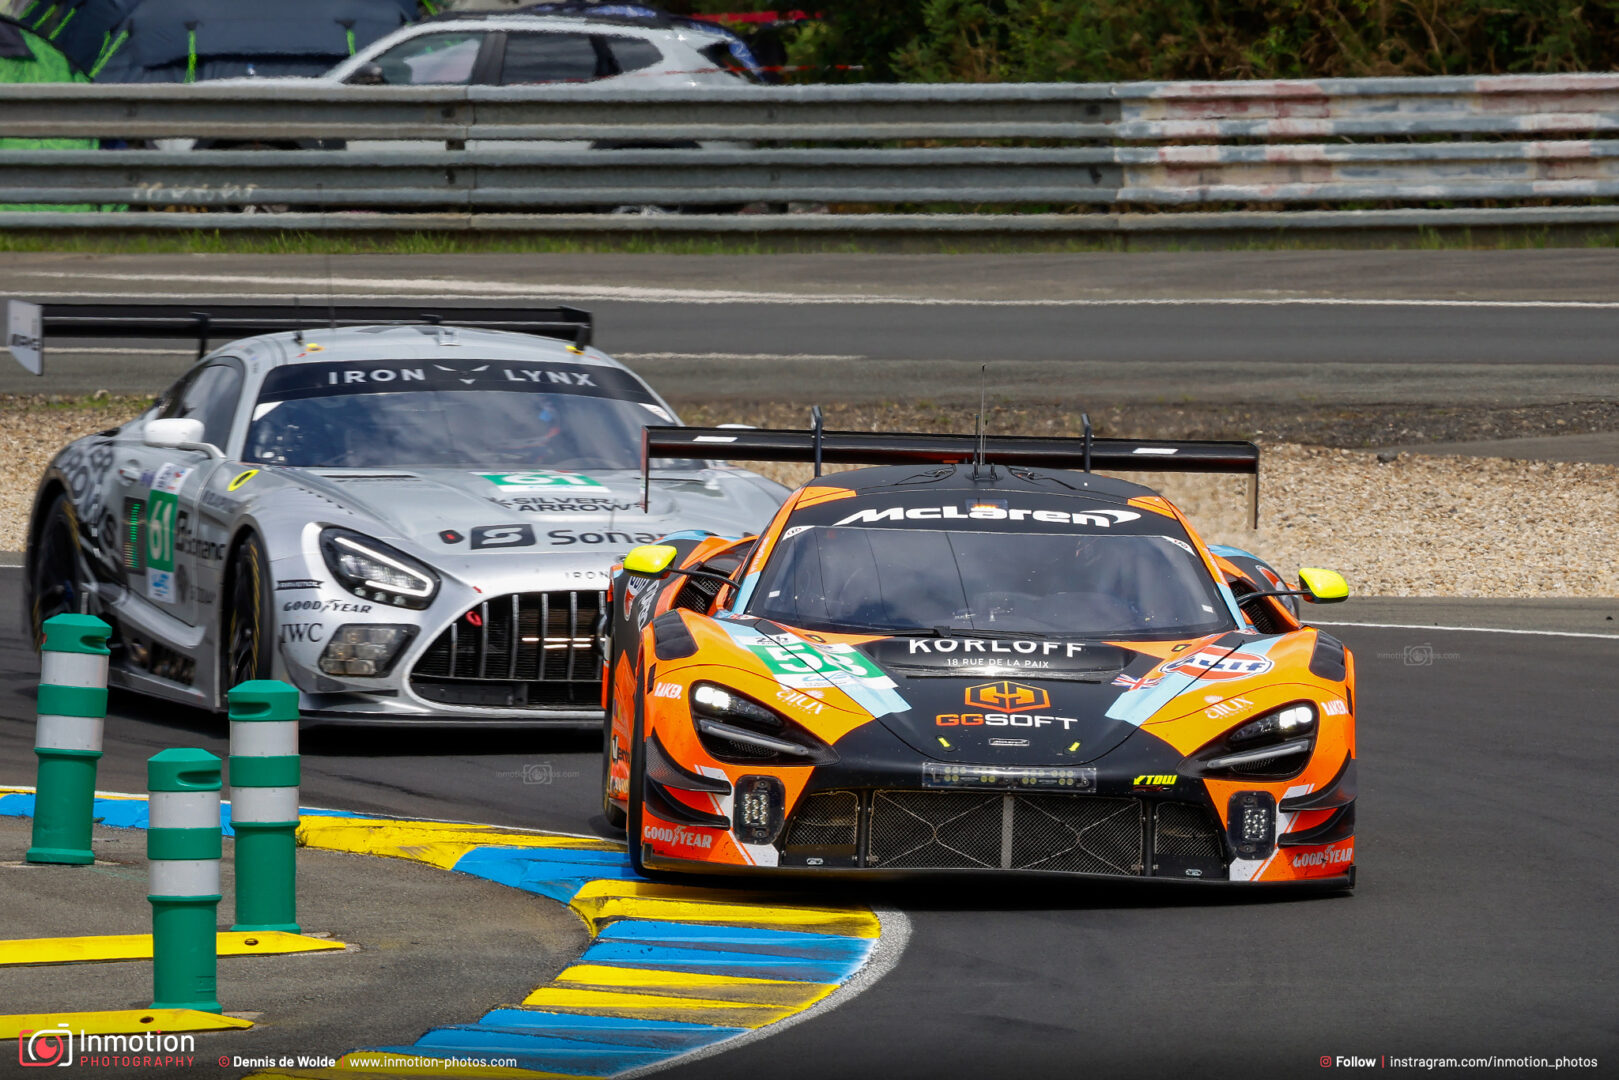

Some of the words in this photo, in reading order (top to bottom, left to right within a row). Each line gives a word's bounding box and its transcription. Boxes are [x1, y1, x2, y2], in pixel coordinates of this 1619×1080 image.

[328, 368, 425, 385] IRON
[503, 369, 598, 387] LYNX
[502, 473, 589, 485] 61
[833, 506, 1112, 528] McLaren
[150, 499, 173, 562] 61
[283, 600, 372, 614] GOODYEAR
[279, 622, 323, 645] IWC
[909, 639, 1087, 658] KORLOFF
[947, 658, 959, 666] 18
[962, 658, 984, 666] RUE
[988, 658, 1003, 667] DE
[1006, 659, 1021, 667] LA
[1024, 660, 1049, 669] PAIX
[935, 713, 1079, 730] GGSOFT
[644, 825, 713, 849] GOODYEAR
[1292, 845, 1353, 868] GOODYEAR
